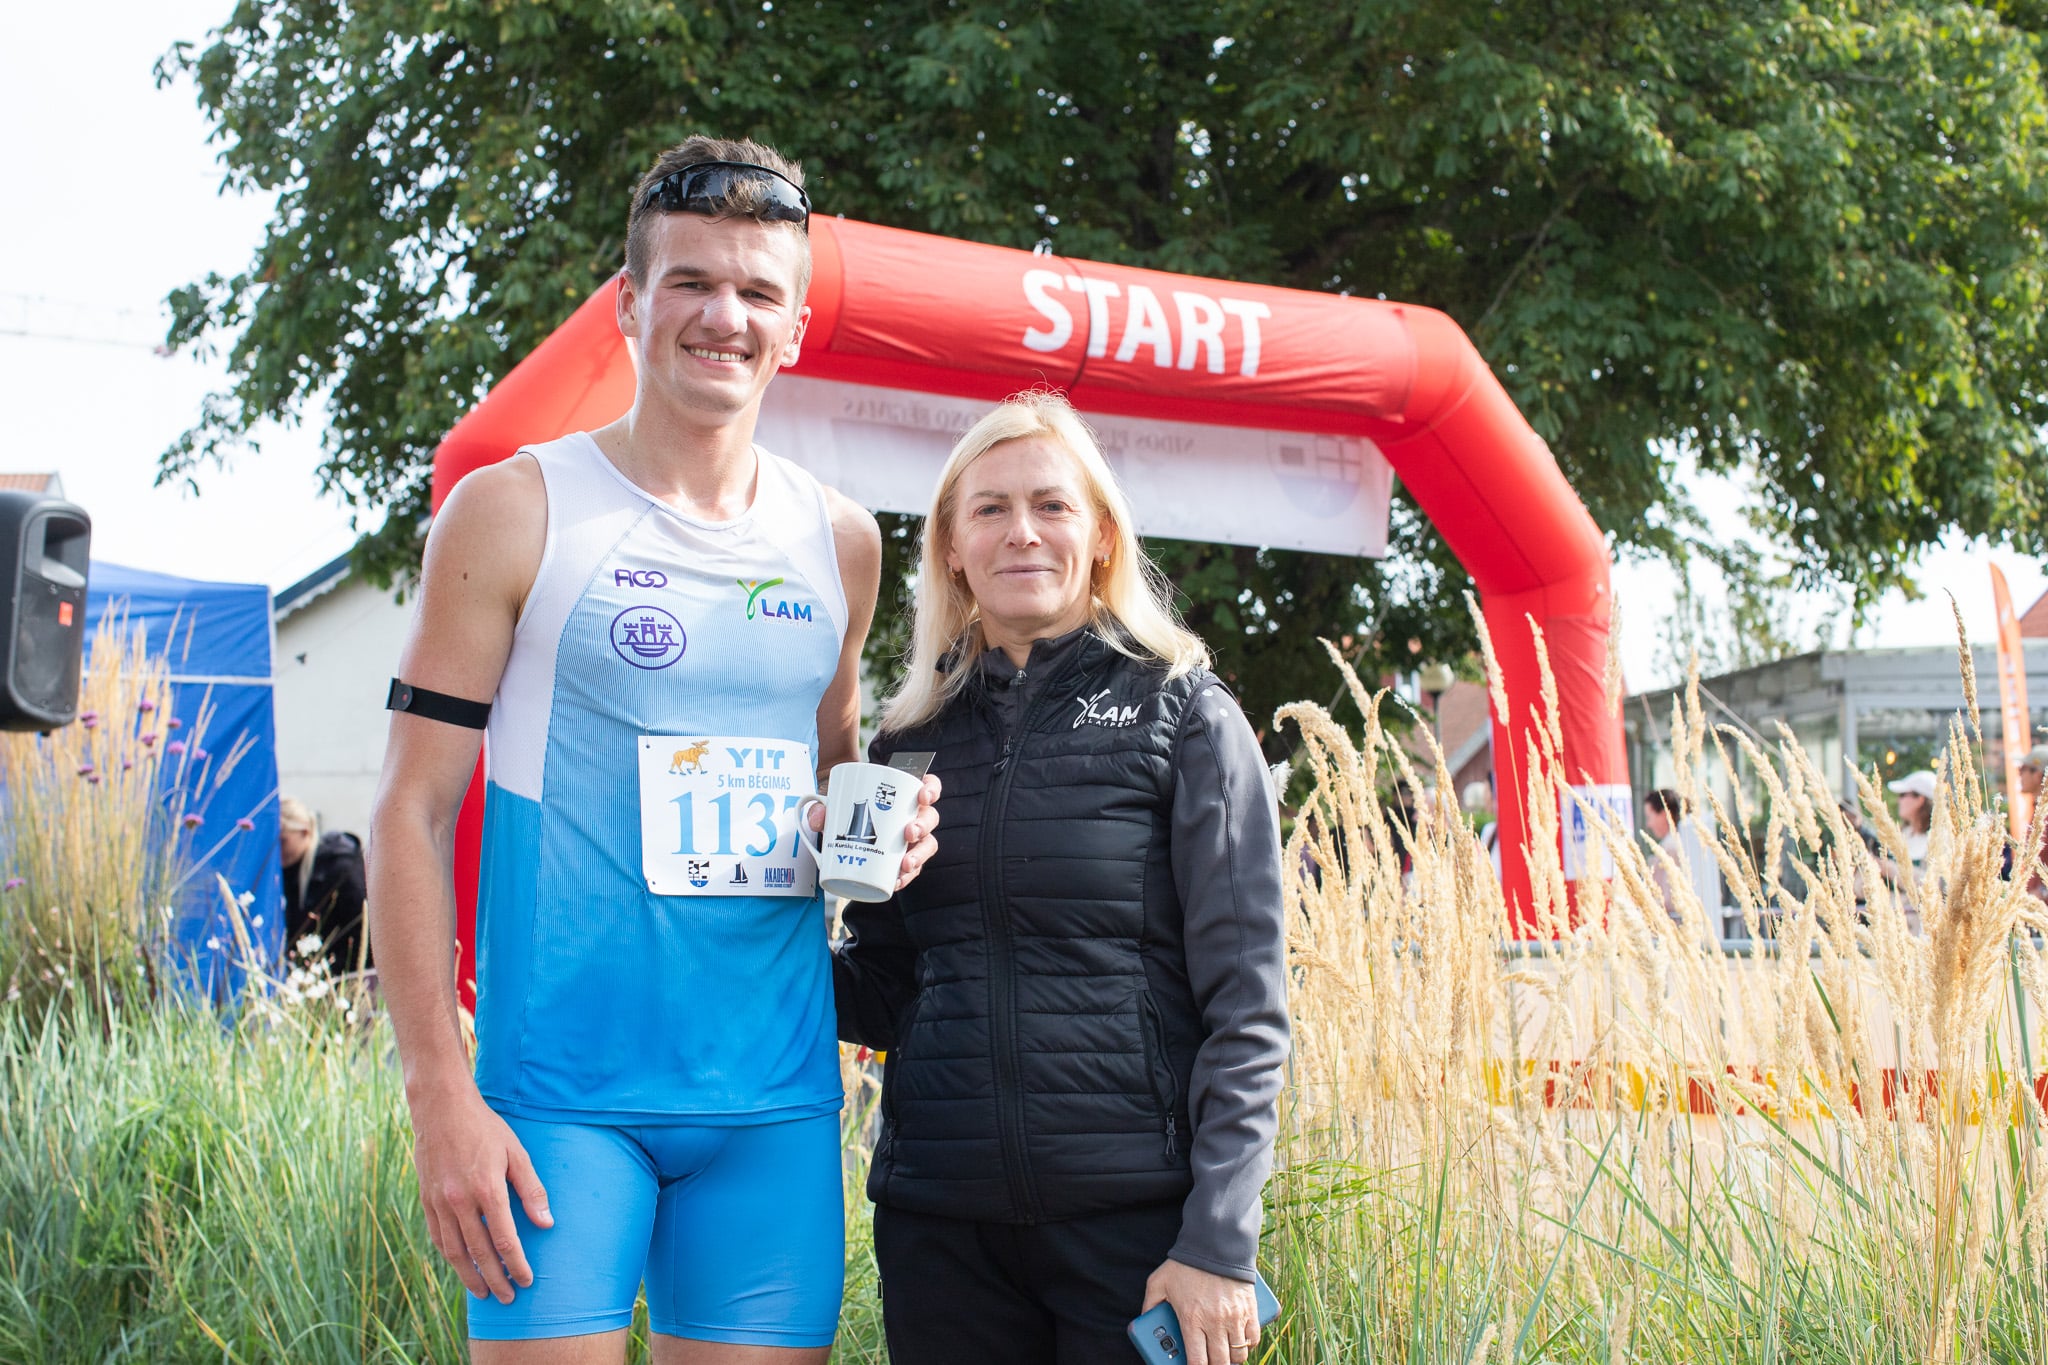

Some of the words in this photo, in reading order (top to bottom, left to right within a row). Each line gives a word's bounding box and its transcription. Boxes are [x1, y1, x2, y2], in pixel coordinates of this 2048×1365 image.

[1022, 268, 1272, 378] START
[725, 747, 785, 770] YIT
[717, 774, 725, 787] 5
[728, 773, 745, 788] km
[748, 772, 791, 790] BĖGIMAS
[854, 844, 885, 855] Legendos
[837, 854, 867, 866] YIT
